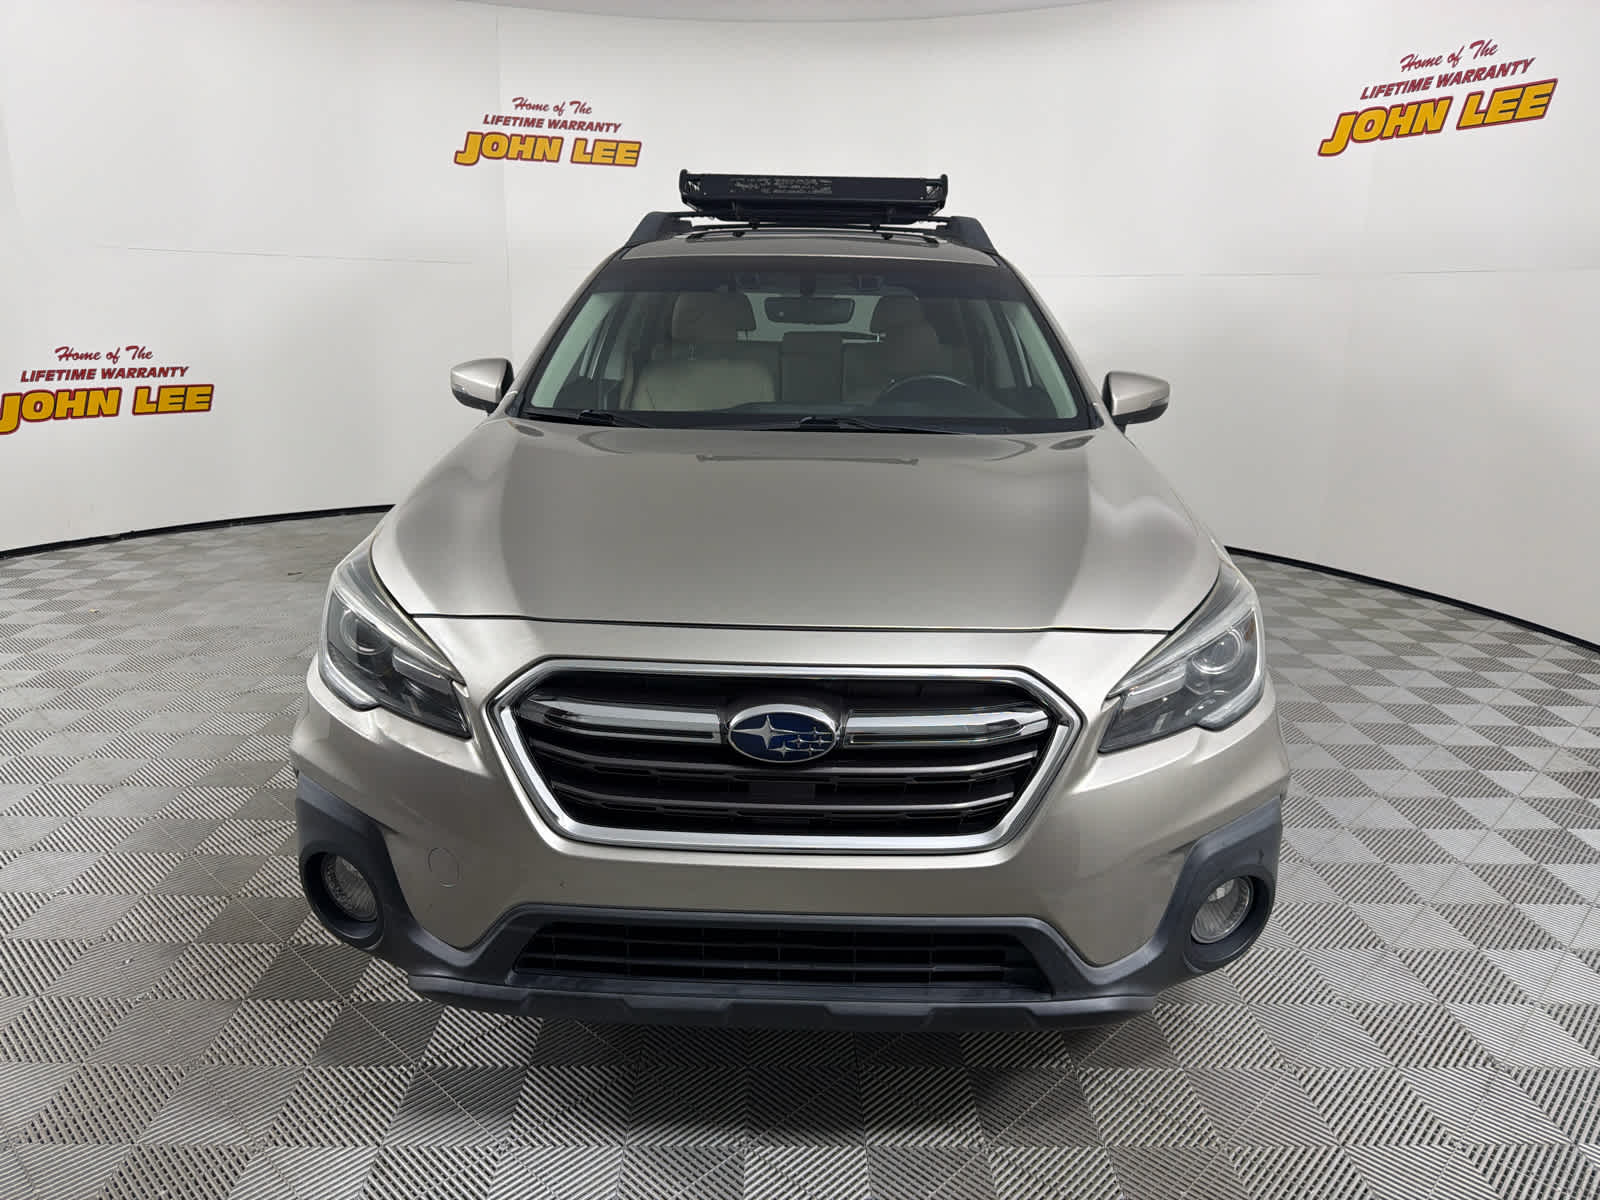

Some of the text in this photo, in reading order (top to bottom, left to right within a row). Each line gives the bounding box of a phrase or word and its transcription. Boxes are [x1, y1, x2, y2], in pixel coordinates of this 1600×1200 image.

[1400, 38, 1498, 72] Home of The
[1360, 57, 1536, 100] LIFETIME WARRANTY
[483, 114, 622, 133] LIFETIME WARRANTY
[512, 96, 592, 117] Home of The
[1317, 78, 1558, 157] JOHN LEE
[454, 131, 642, 167] JOHN LEE
[54, 345, 153, 364] Home of The
[20, 366, 189, 383] LIFETIME WARRANTY
[0, 384, 214, 435] JOHN LEE
